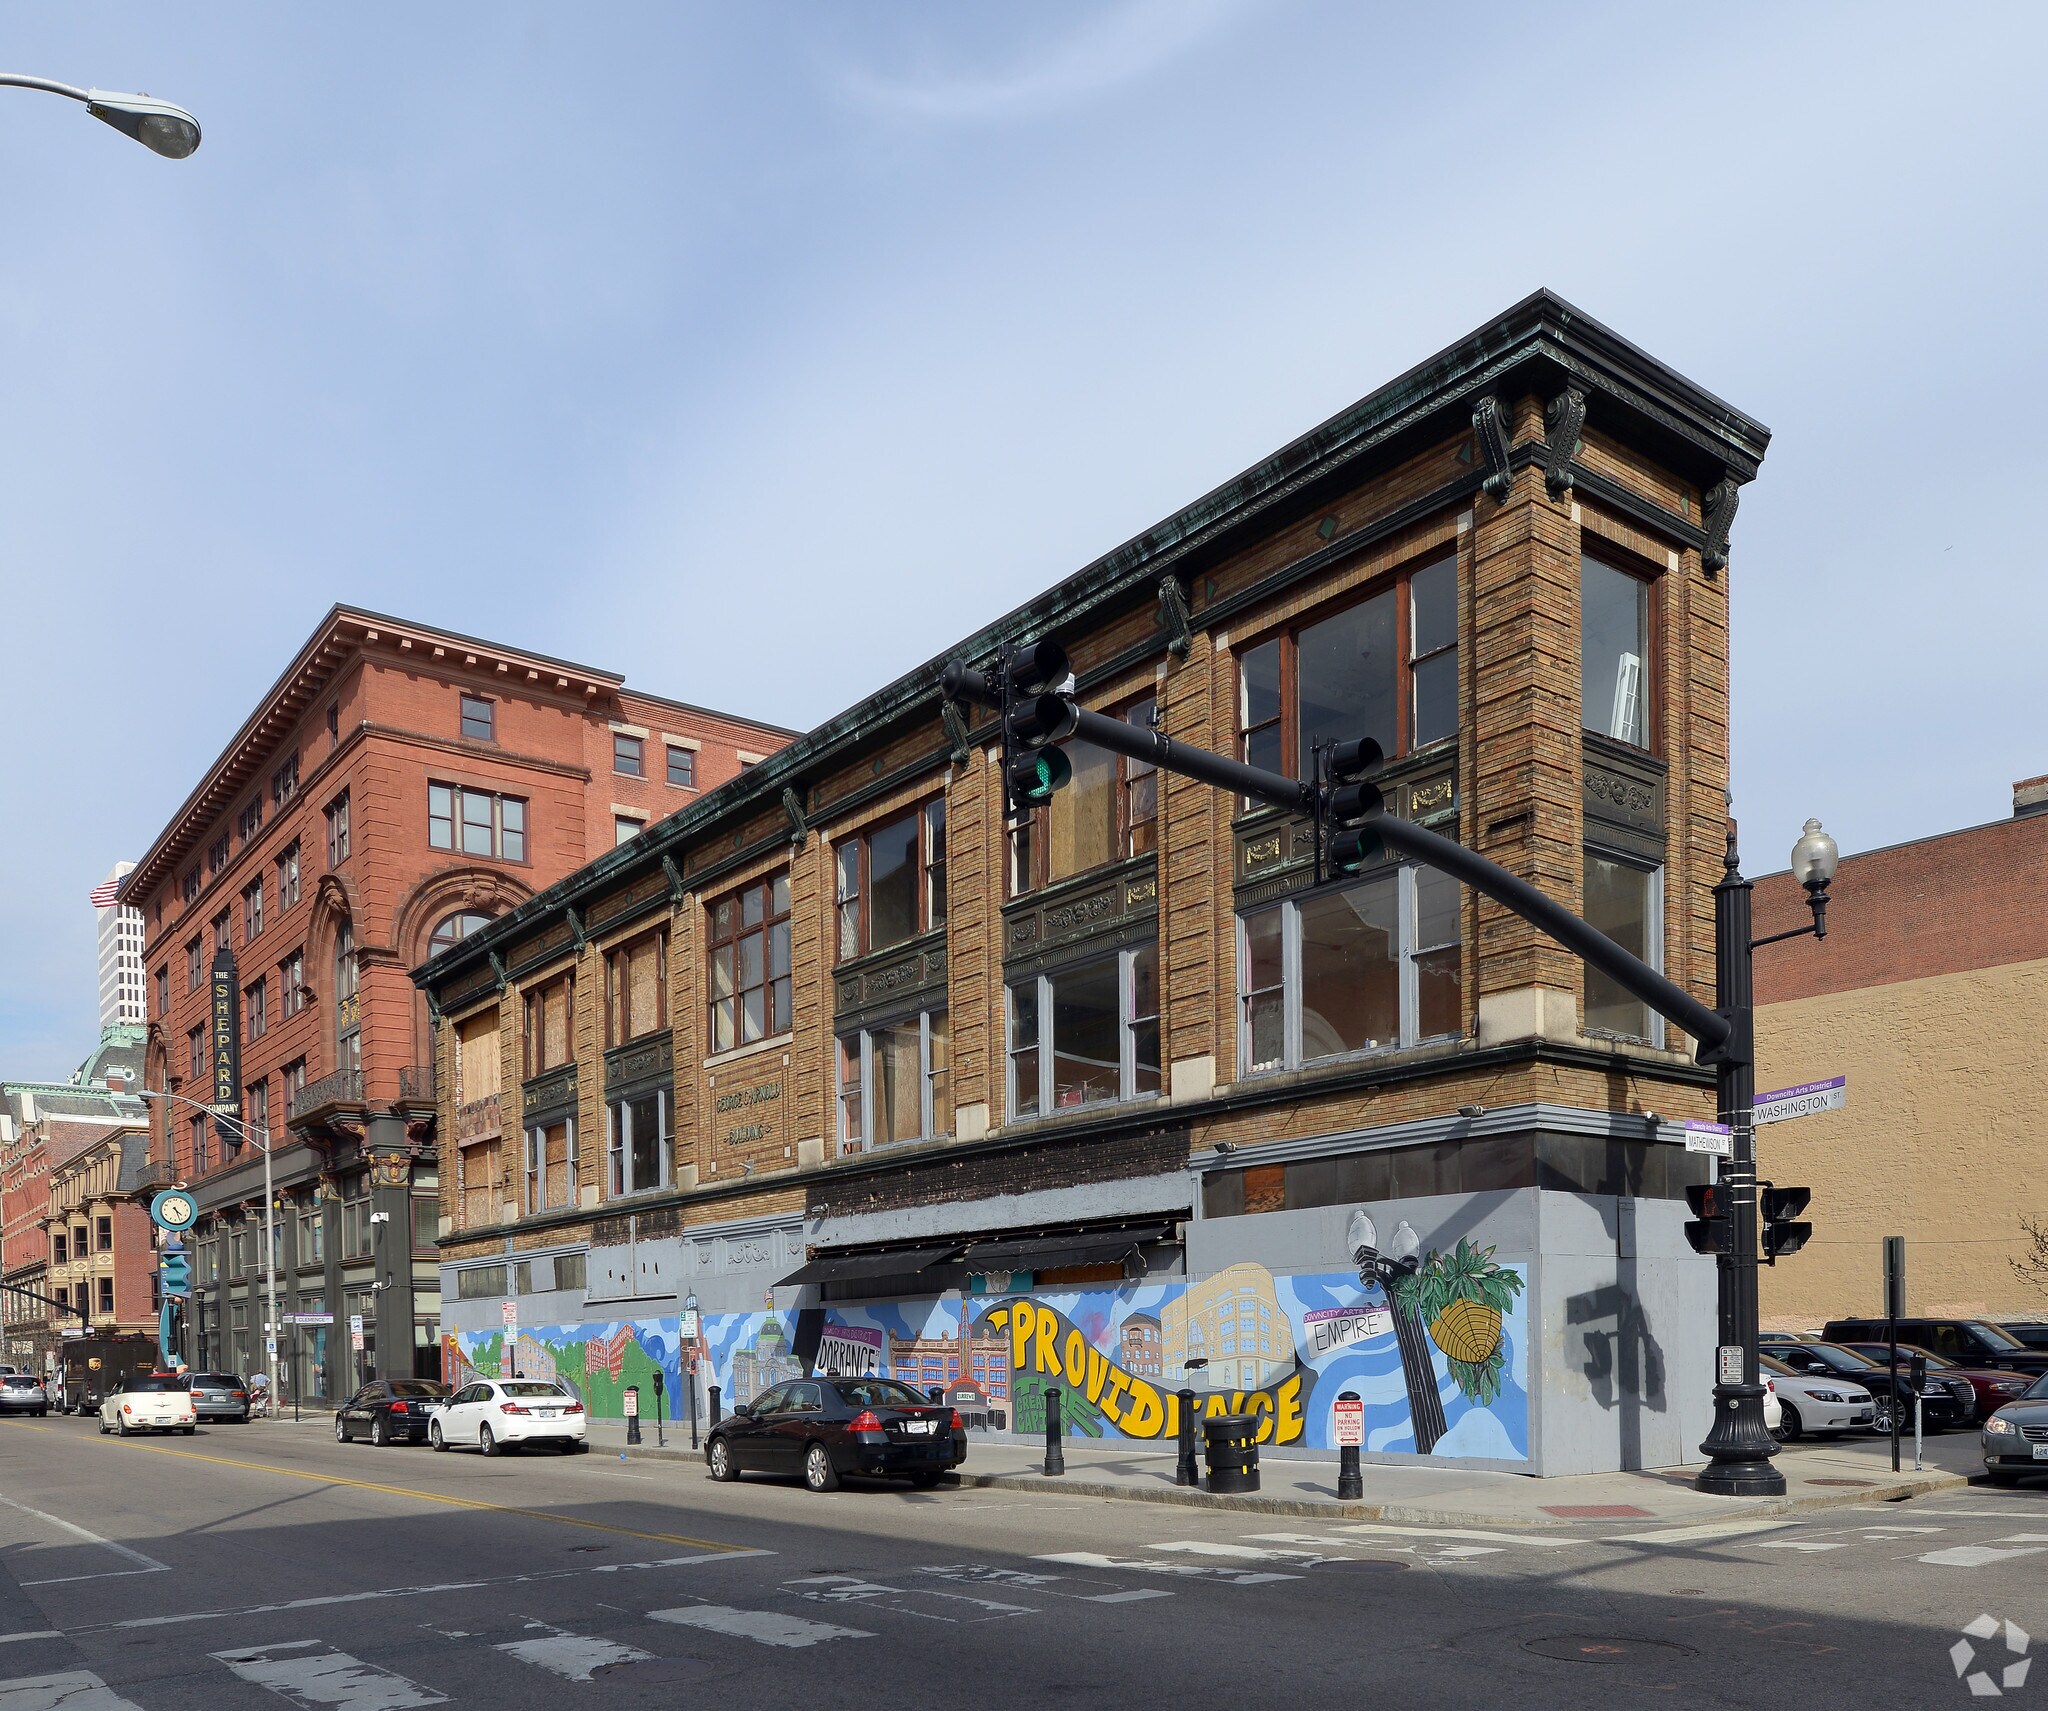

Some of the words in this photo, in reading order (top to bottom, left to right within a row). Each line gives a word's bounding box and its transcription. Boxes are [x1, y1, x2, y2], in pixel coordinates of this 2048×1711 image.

[214, 971, 229, 979] THE
[215, 984, 232, 1099] SHEPARD
[1766, 1088, 1795, 1101] Downcity
[1795, 1086, 1808, 1096] Arts
[1809, 1080, 1833, 1093] District
[1757, 1095, 1829, 1120] WASHINGTON
[1688, 1135, 1721, 1151] MATHEWSON
[1303, 1308, 1340, 1323] DOWNCITY
[1342, 1308, 1364, 1316] ARTS
[1314, 1314, 1379, 1351] EMPIRE
[818, 1337, 876, 1377] DORRANCE
[1336, 1403, 1361, 1411] WARNING
